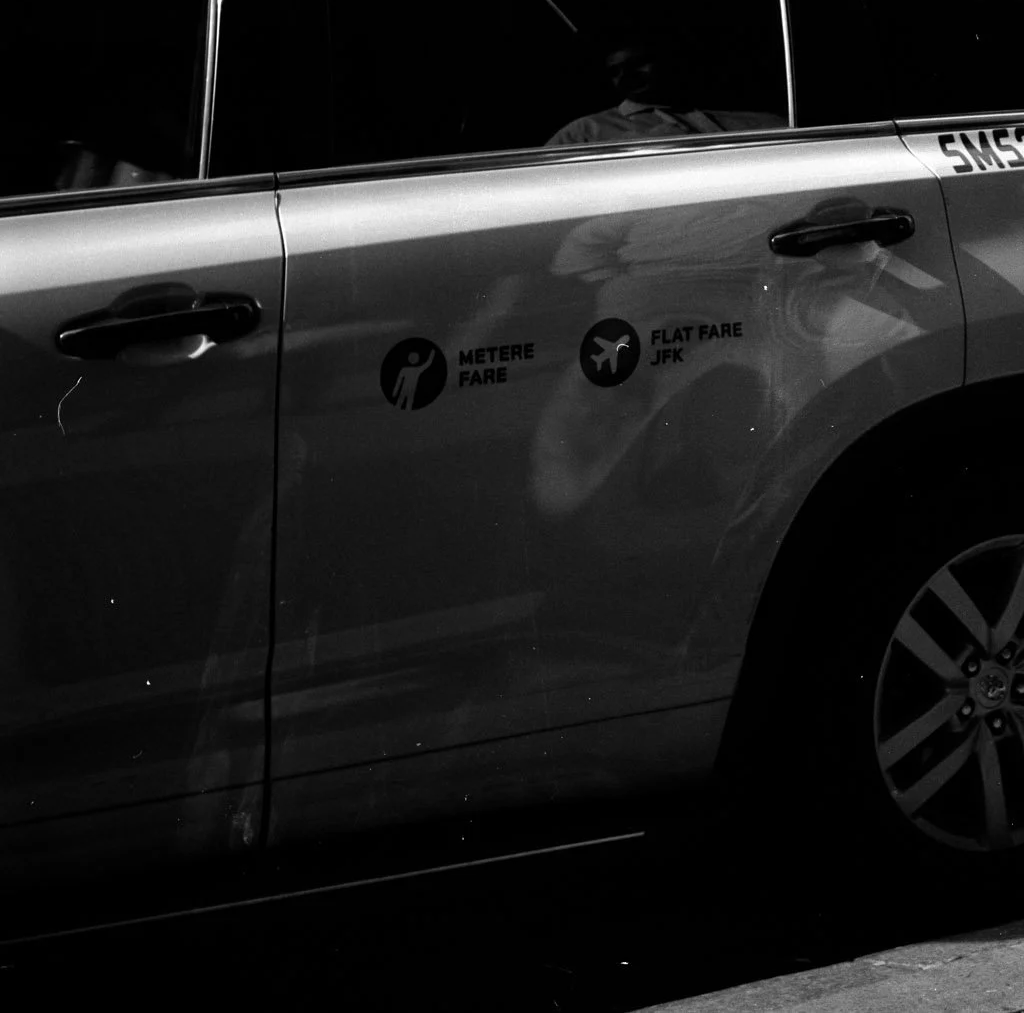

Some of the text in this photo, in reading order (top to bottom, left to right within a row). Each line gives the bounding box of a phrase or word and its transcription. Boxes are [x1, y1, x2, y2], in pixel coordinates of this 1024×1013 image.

[651, 322, 743, 346] FLAT FARE
[459, 343, 535, 366] METERE
[650, 348, 684, 366] JFK
[459, 367, 508, 387] FARE
